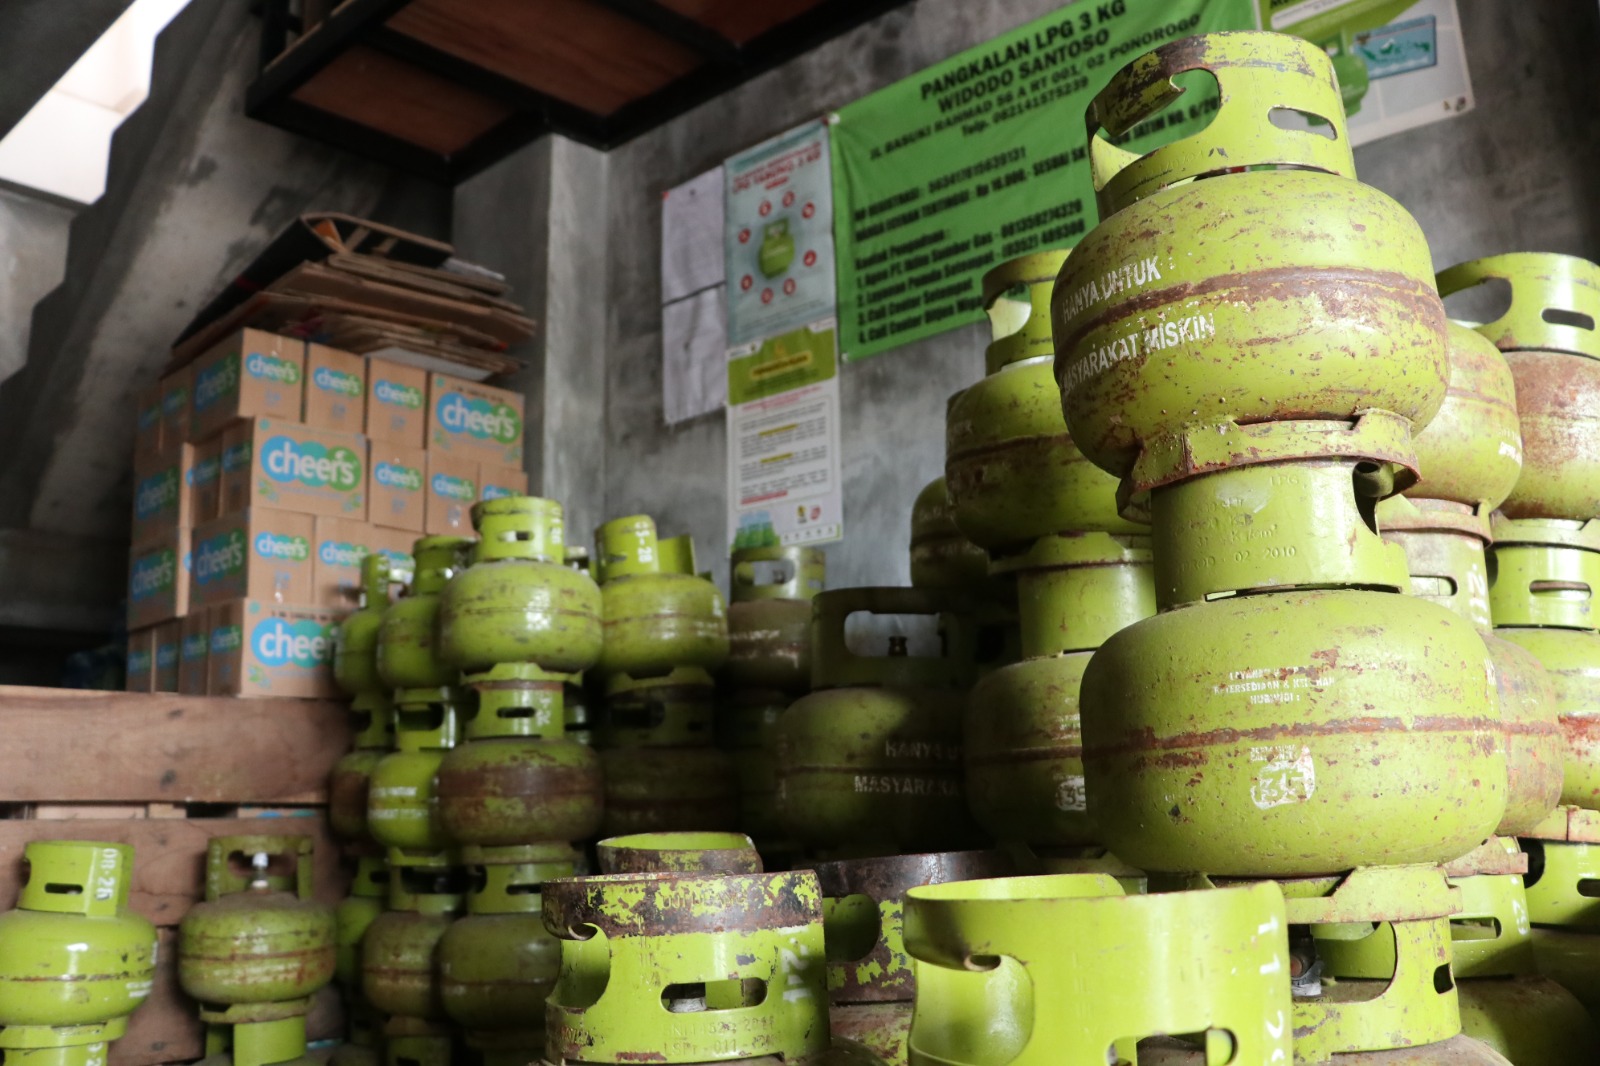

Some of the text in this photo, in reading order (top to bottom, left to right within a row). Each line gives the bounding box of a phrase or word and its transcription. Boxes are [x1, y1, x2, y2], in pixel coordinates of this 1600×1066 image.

[921, 0, 1125, 100] PANGKALAN LPG 3 KG
[939, 27, 1108, 113] WIDODO SANTOSO
[1030, 75, 1047, 93] RT
[1109, 11, 1200, 61] PONOROGO
[1100, 256, 1161, 300] UNTUK
[1144, 312, 1216, 354] MISKIN
[250, 355, 296, 382] cheers
[316, 369, 359, 394] cheers
[378, 383, 419, 405] cheers
[443, 397, 516, 438] cheers
[268, 441, 355, 486] cheers
[378, 465, 419, 488] cheers
[434, 476, 475, 499] cheers
[257, 534, 307, 558] cheers
